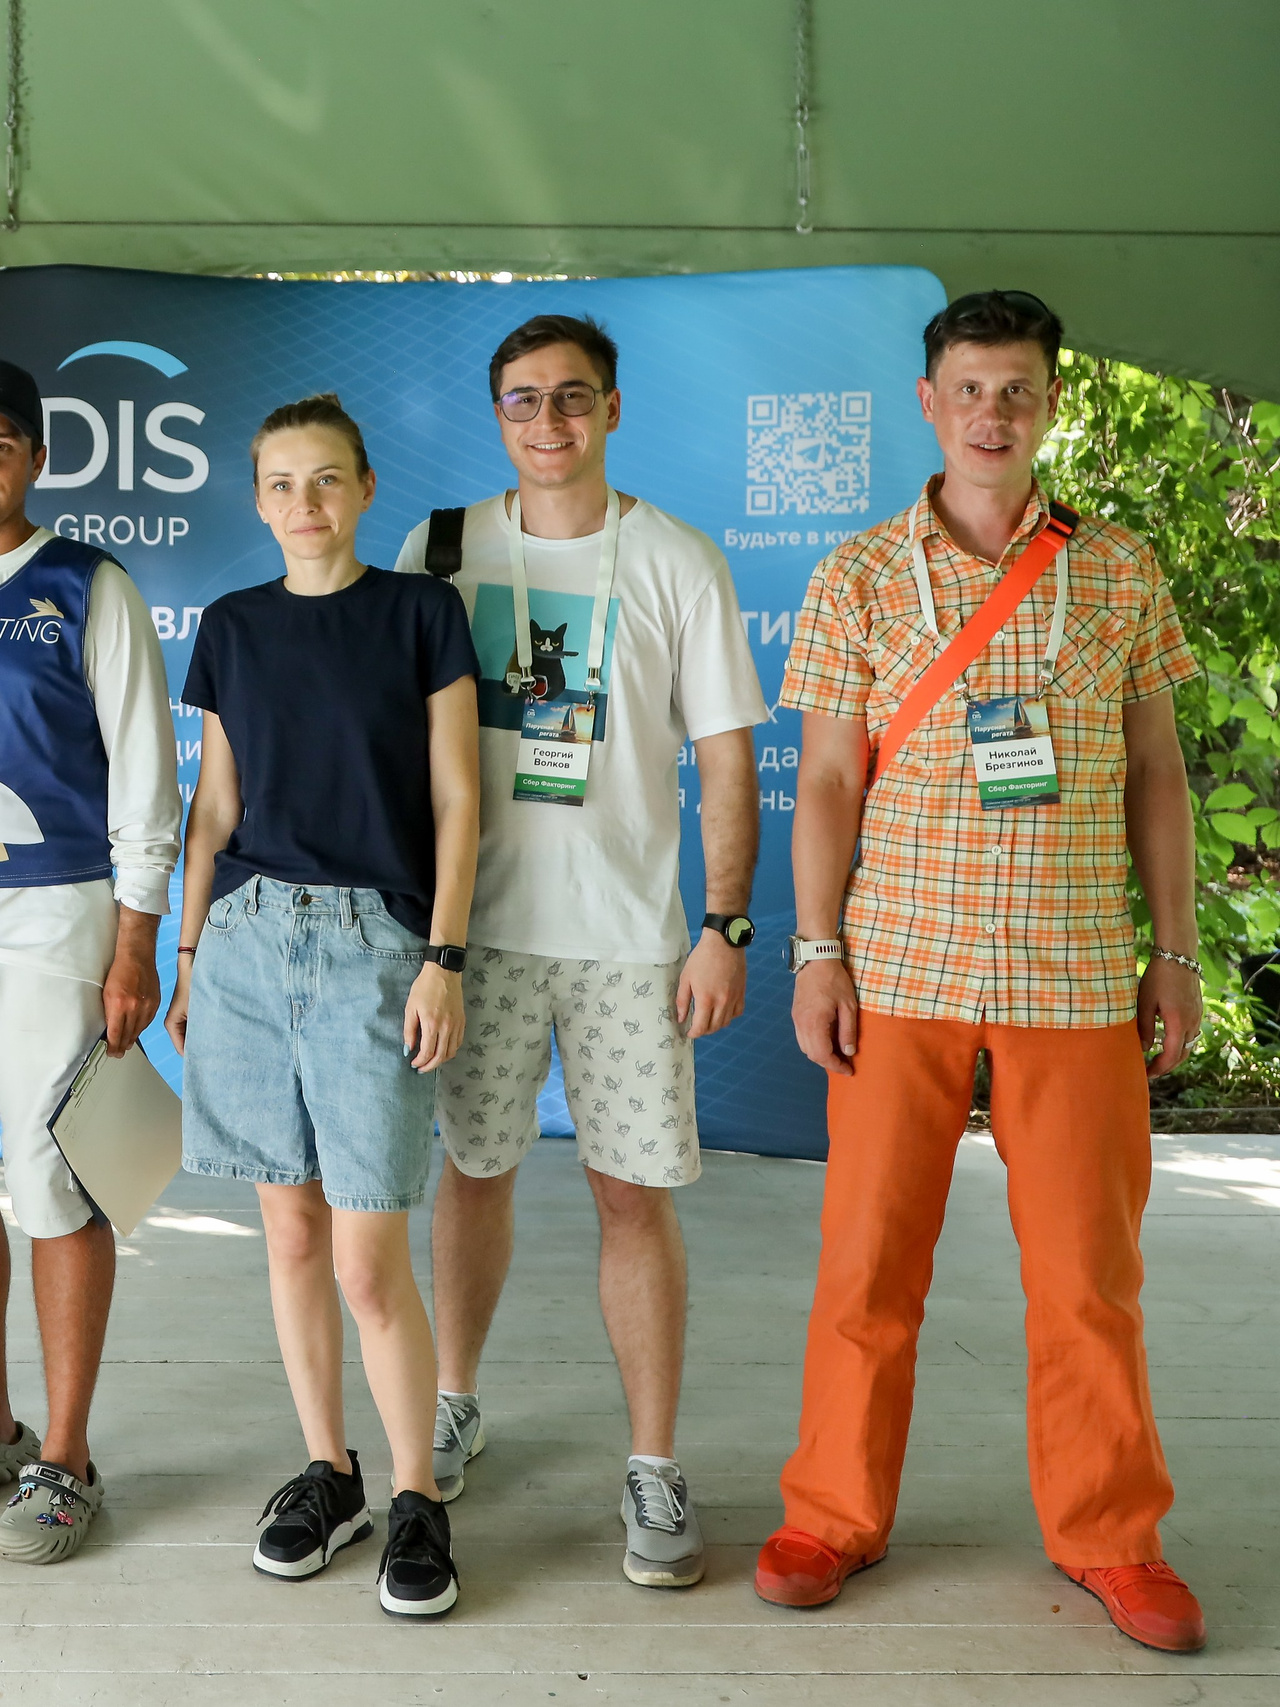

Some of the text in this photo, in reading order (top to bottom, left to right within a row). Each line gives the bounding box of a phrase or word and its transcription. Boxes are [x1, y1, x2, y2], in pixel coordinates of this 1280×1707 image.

[34, 396, 210, 493] DIS
[54, 513, 190, 546] GROUP
[724, 528, 801, 550] Будьте
[807, 531, 819, 545] в
[534, 748, 573, 759] Георгий
[989, 747, 1036, 759] Николай
[534, 758, 570, 768] Волков
[986, 759, 1044, 772] Брезгинов
[541, 781, 576, 789] Факторинг
[1009, 781, 1047, 790] Факторинг
